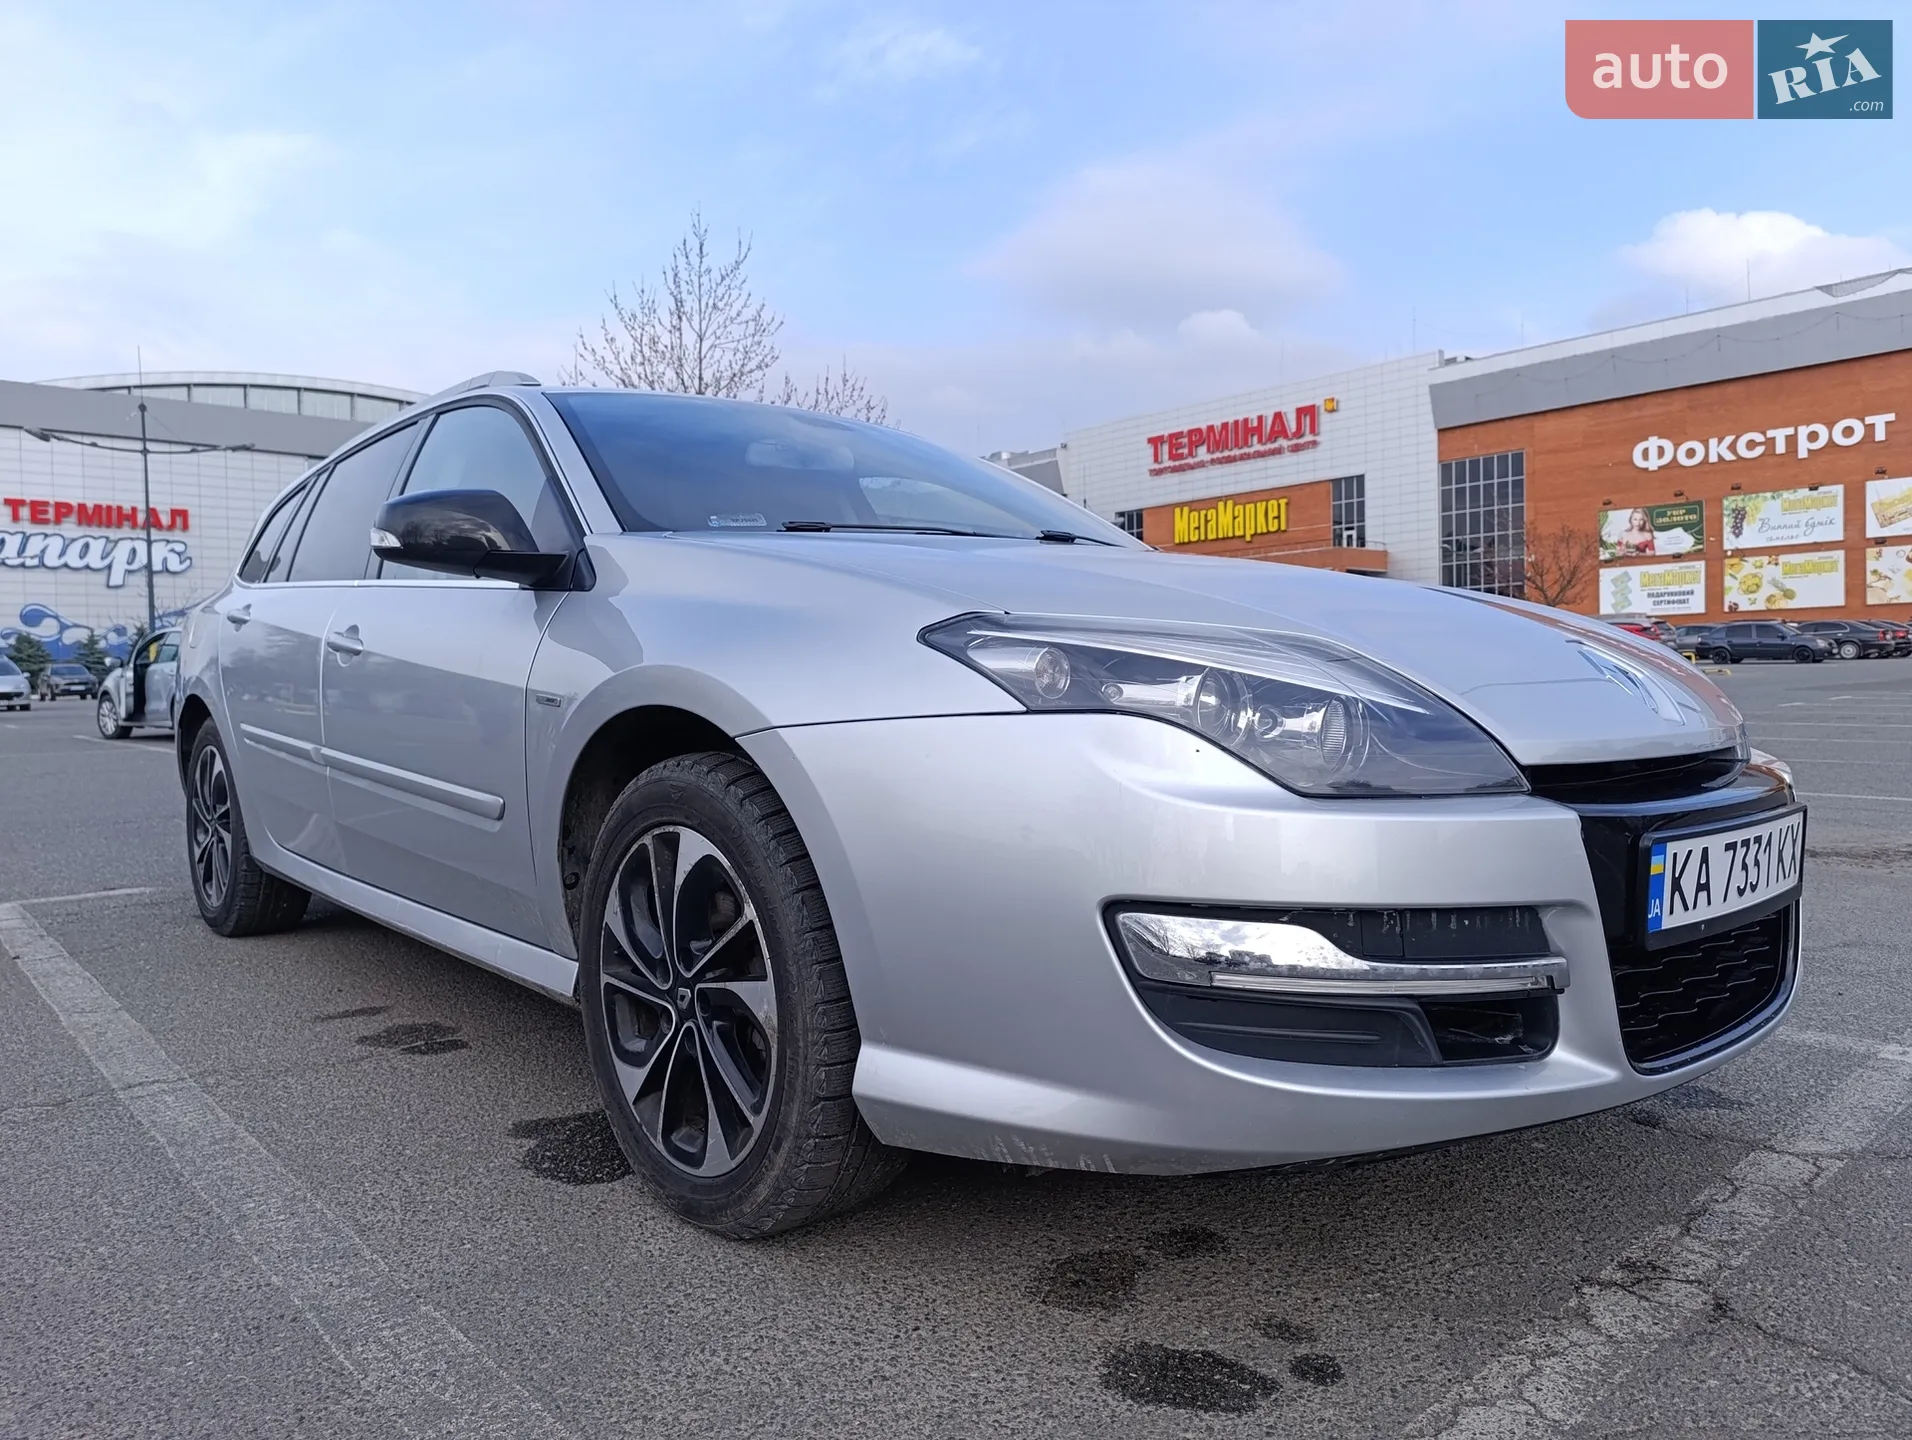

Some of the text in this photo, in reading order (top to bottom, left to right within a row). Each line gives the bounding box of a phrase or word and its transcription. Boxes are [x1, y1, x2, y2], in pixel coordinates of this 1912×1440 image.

[1147, 404, 1318, 464] ТЕРМІНАЛ
[1632, 412, 1896, 471] Фокстрот
[4, 498, 190, 532] ТЕРМІНАЛ
[1174, 497, 1289, 545] МегаМаркет
[1669, 821, 1801, 916] KA 7331 KX
